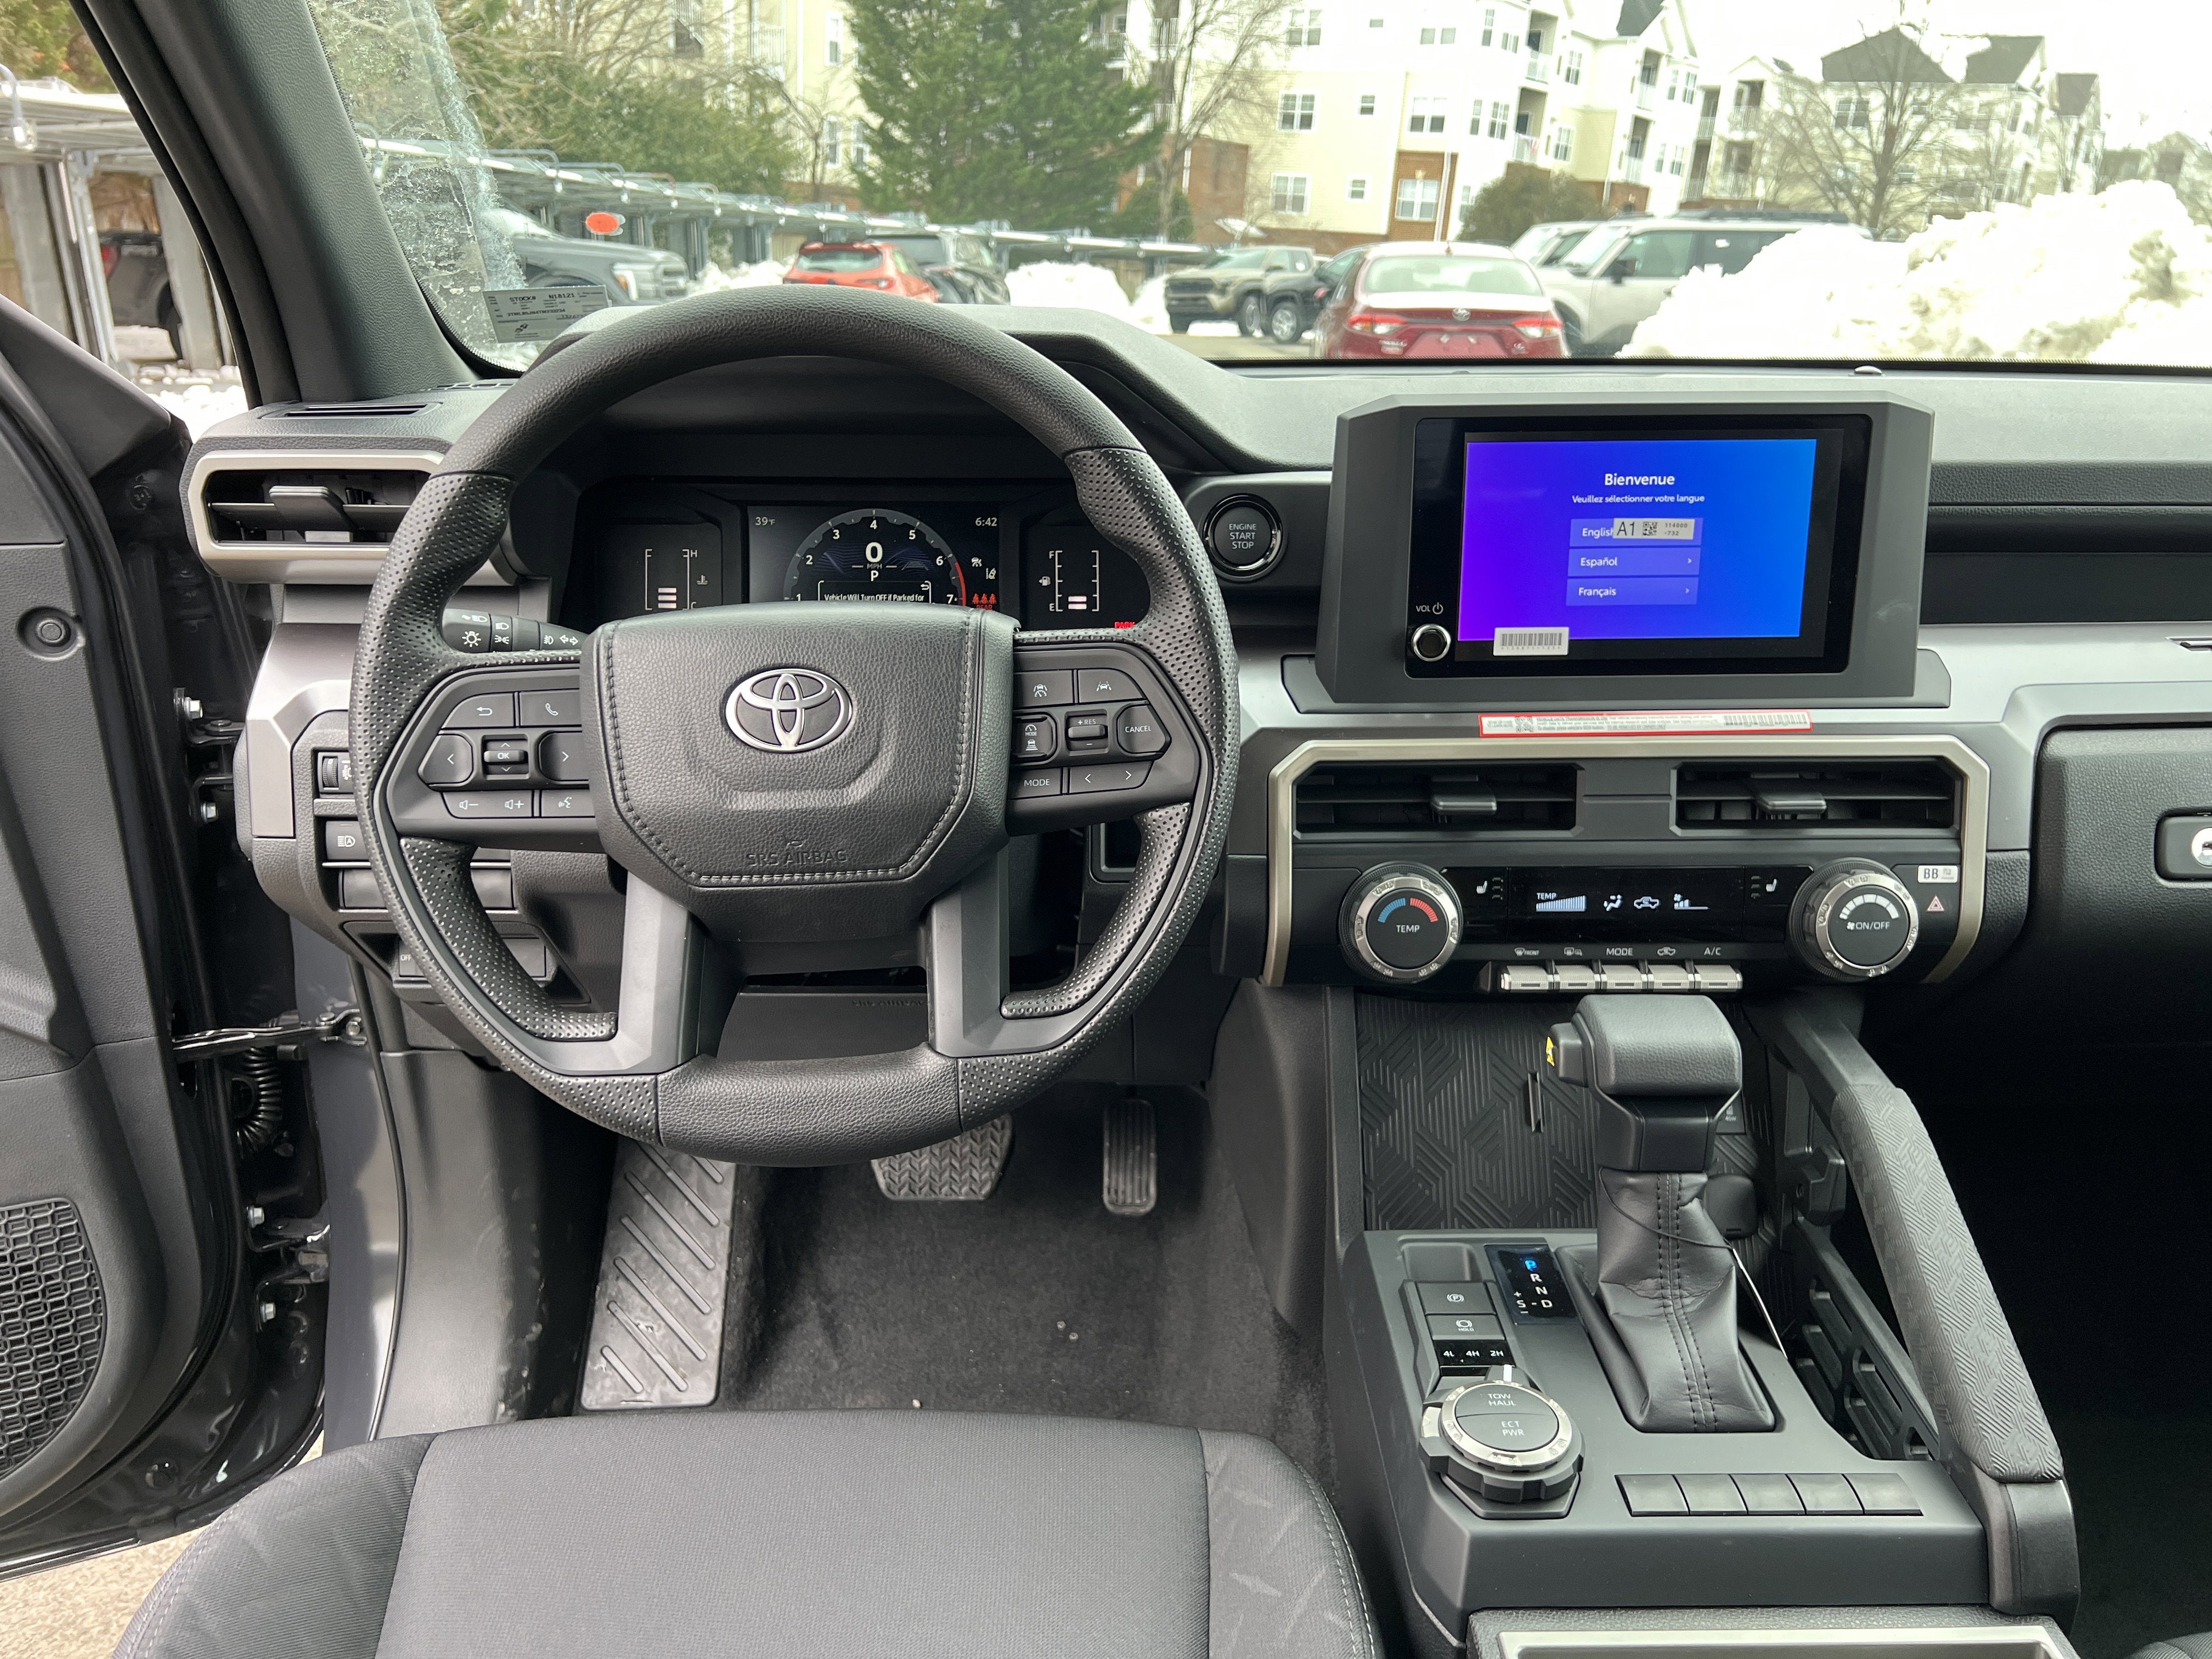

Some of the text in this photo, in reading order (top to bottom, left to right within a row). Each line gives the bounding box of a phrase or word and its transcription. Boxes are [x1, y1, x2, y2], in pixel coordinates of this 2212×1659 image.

[1604, 473, 1675, 486] Bienvenue
[1572, 495, 1603, 503] Veuillez
[1605, 494, 1652, 503] sélectionner
[1677, 494, 1705, 504] langue
[870, 520, 877, 529] 4
[975, 517, 997, 527] 6:42
[1616, 521, 1635, 536] A1
[833, 529, 840, 539] 3
[909, 529, 916, 539] 5
[1232, 541, 1254, 549] STOP
[865, 541, 883, 563] 0
[1049, 551, 1054, 559] F
[805, 556, 813, 565] 2
[936, 556, 943, 566] 6
[1581, 557, 1618, 568] Español
[871, 571, 878, 582] P
[1578, 587, 1616, 598] Français
[946, 595, 953, 603] 7
[1024, 778, 1050, 787] MODE
[746, 850, 848, 867] SRS AIRBAG
[1924, 868, 1938, 879] BB
[1536, 892, 1557, 900] TEMP
[1396, 924, 1420, 933] TEMP
[1855, 921, 1890, 929] ON/OFF
[1606, 947, 1634, 957] MODE
[1704, 947, 1722, 956] A/C
[1525, 1260, 1537, 1271] P
[1530, 1273, 1542, 1283] R
[1536, 1286, 1548, 1295] N
[1516, 1300, 1553, 1308] S D
